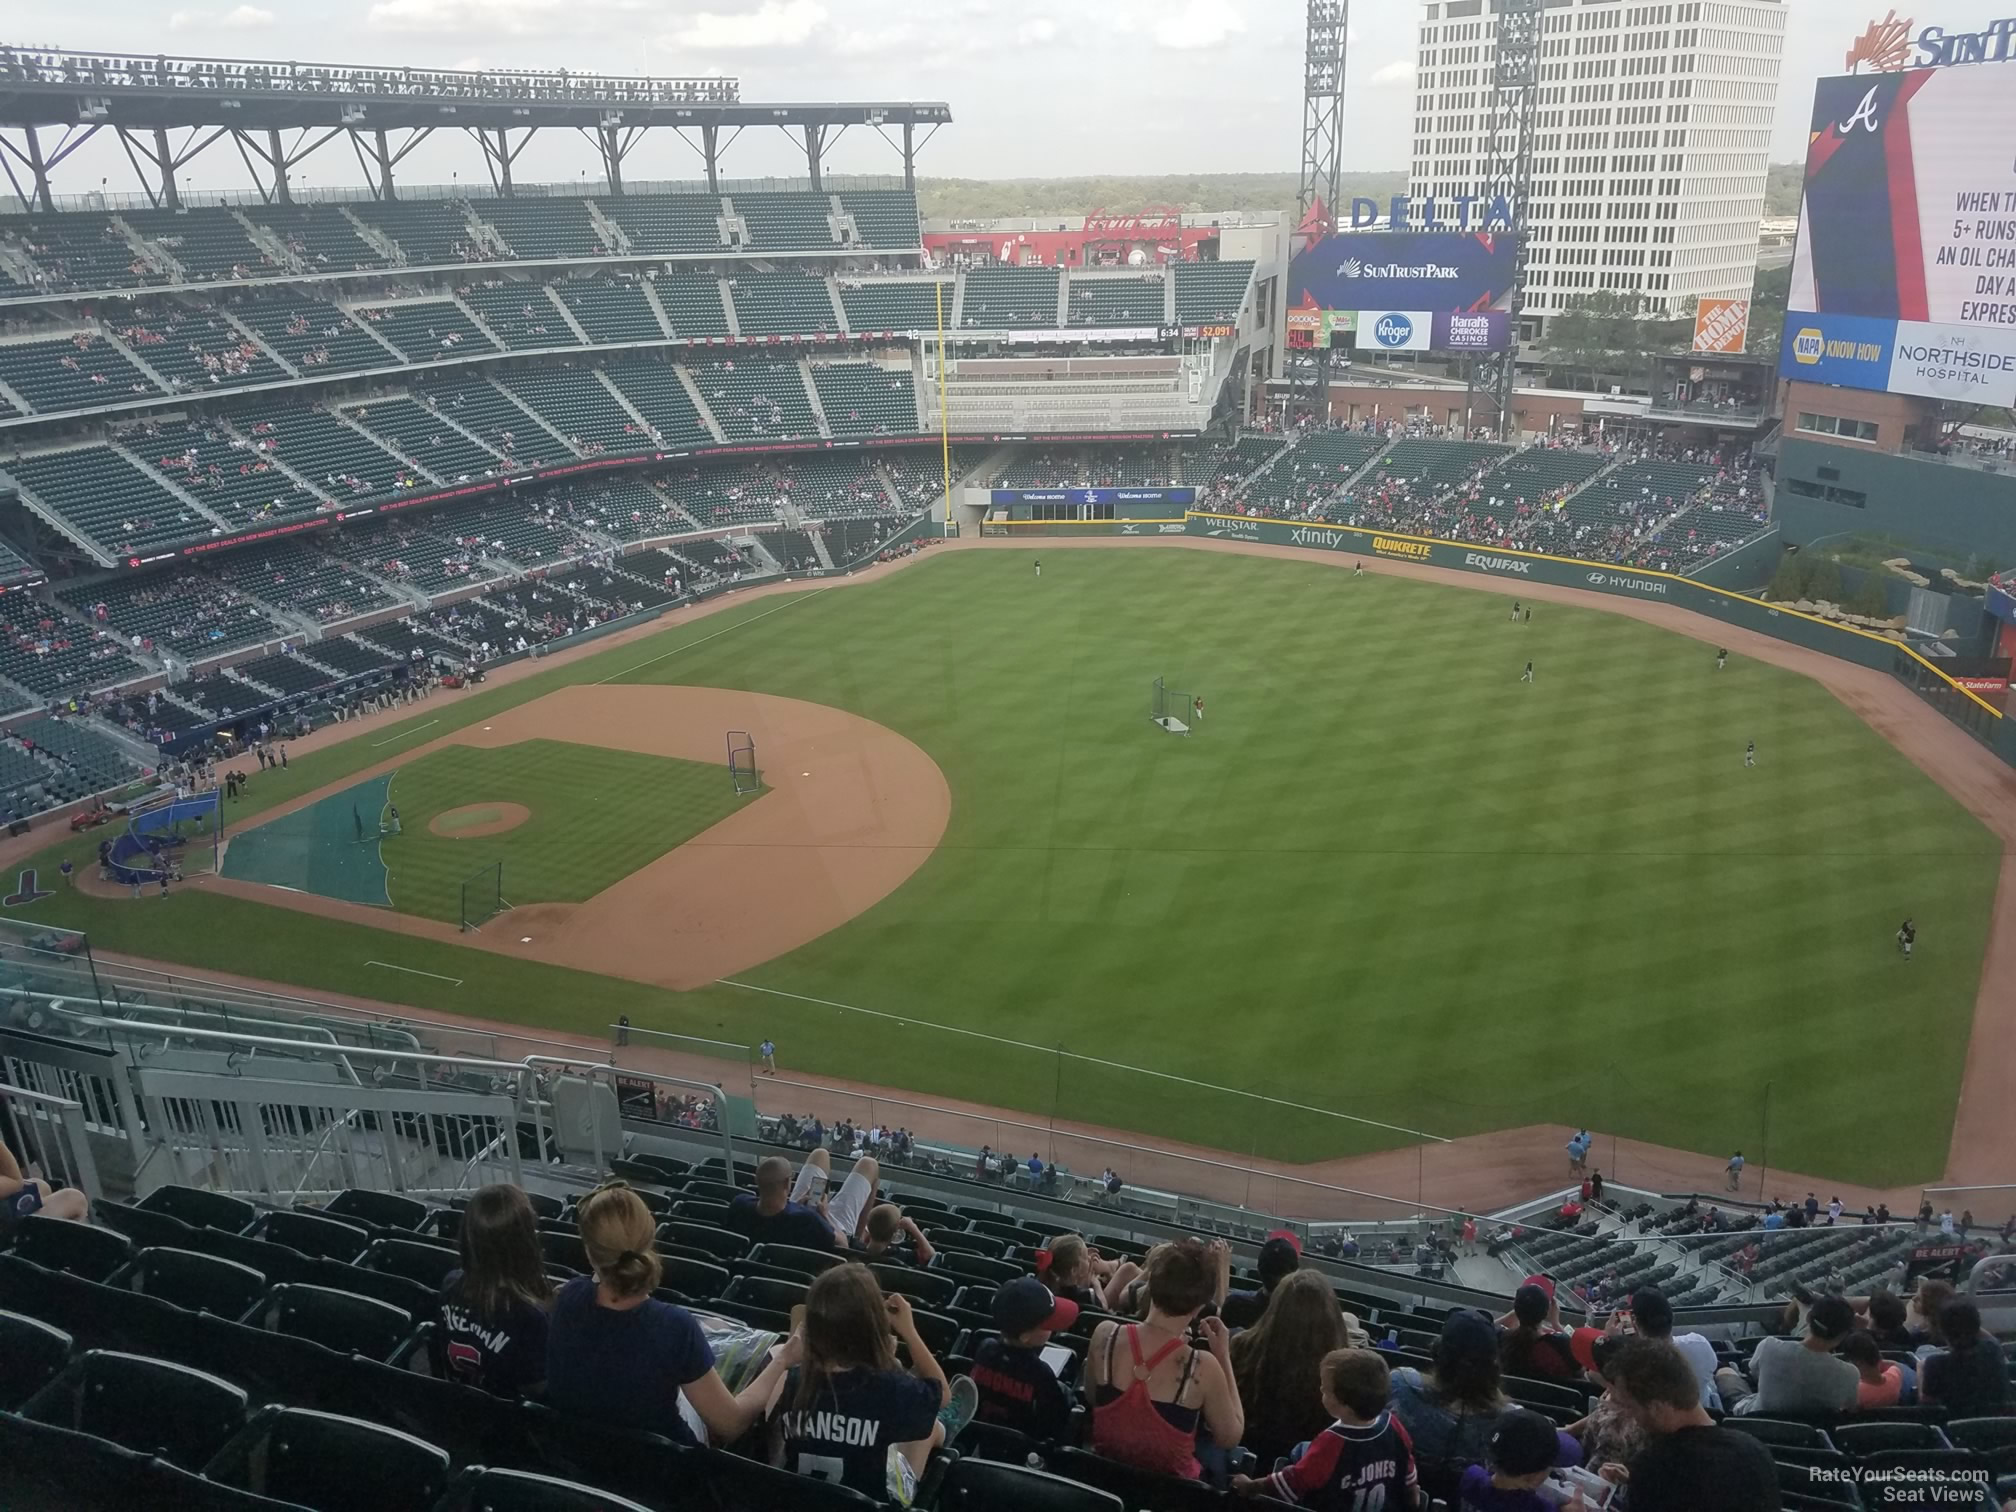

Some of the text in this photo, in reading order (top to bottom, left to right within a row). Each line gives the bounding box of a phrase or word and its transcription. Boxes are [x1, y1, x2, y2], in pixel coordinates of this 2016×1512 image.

[1352, 194, 1512, 229] DELTA
[1956, 192, 2000, 212] WHEN
[1953, 220, 1971, 239] 5+
[1936, 246, 1956, 265] AN
[1960, 247, 1982, 267] OIL
[1976, 275, 2004, 296] DAY
[1451, 316, 1489, 328] Harrah's
[1701, 304, 1724, 325] THE
[906, 330, 918, 340] 42
[1160, 328, 1178, 337] 6:34
[1202, 326, 1230, 337] $2,091
[1378, 318, 1410, 344] Kroger
[1695, 300, 1746, 350] HOME
[1713, 319, 1745, 351] DEPOT
[1797, 336, 1881, 362] NAPA KNOW HOW
[1899, 346, 2016, 372] NORTHSIDE
[1916, 366, 1989, 384] HOSPITAL
[1206, 518, 1257, 530] WELLSTAR
[1291, 527, 1343, 548] xfinity
[1372, 537, 1431, 556] QUIKRETE
[1465, 552, 1530, 574] EQUIFAX
[1609, 576, 1666, 594] HYUNDAI
[1931, 1248, 1960, 1256] ALERT
